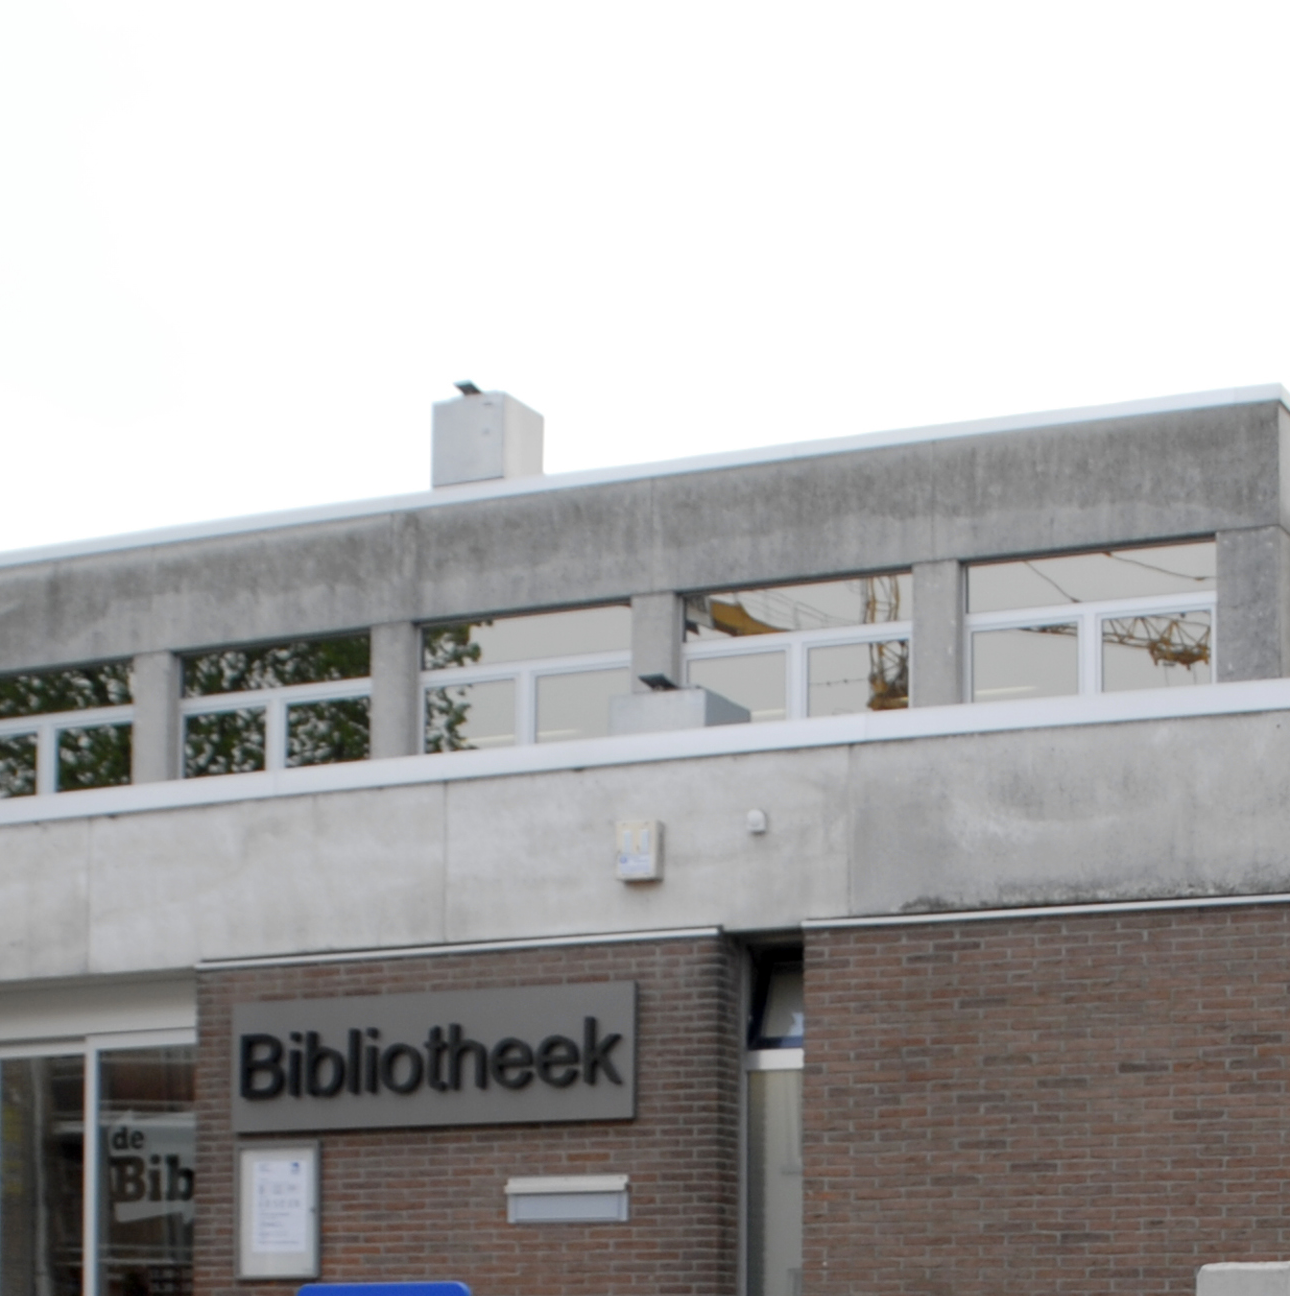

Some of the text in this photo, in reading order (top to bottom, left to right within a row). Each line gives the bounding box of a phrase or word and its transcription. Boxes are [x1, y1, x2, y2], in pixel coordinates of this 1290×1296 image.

[240, 1015, 624, 1099] Bibliotheek
[112, 1126, 145, 1150] de
[108, 1154, 194, 1203] Bib
